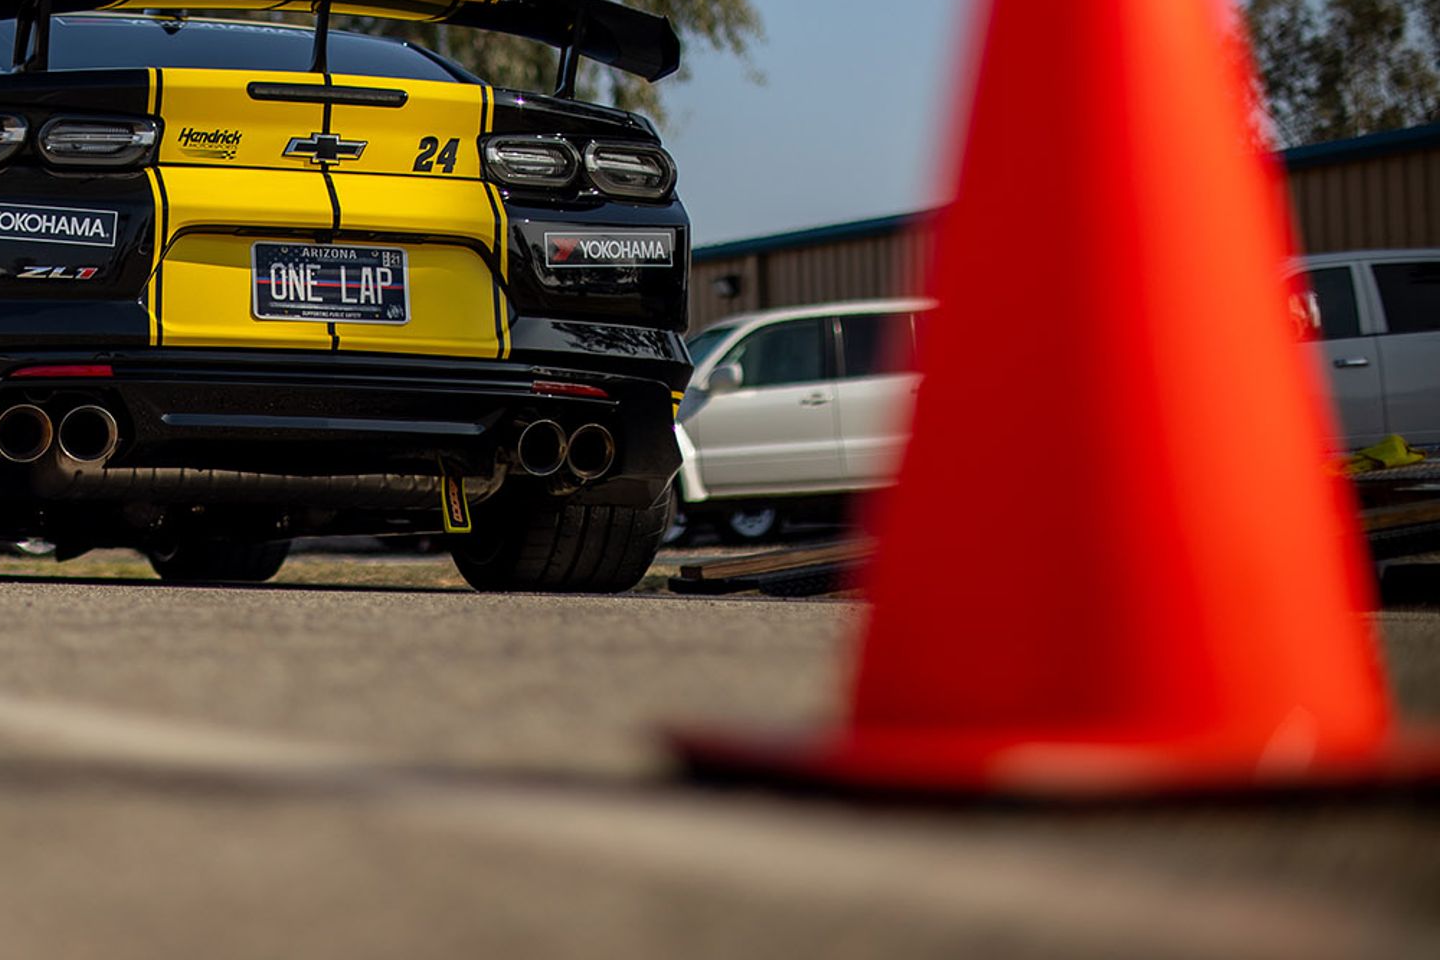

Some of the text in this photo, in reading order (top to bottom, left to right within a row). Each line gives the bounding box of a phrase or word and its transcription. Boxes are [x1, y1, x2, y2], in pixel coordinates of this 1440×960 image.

[177, 127, 243, 147] Hendrick
[412, 135, 461, 173] 24
[301, 247, 358, 260] ARIZONA
[579, 240, 666, 259] YOKOHAMA
[16, 266, 99, 279] ZL1
[270, 262, 393, 305] ONE LAP
